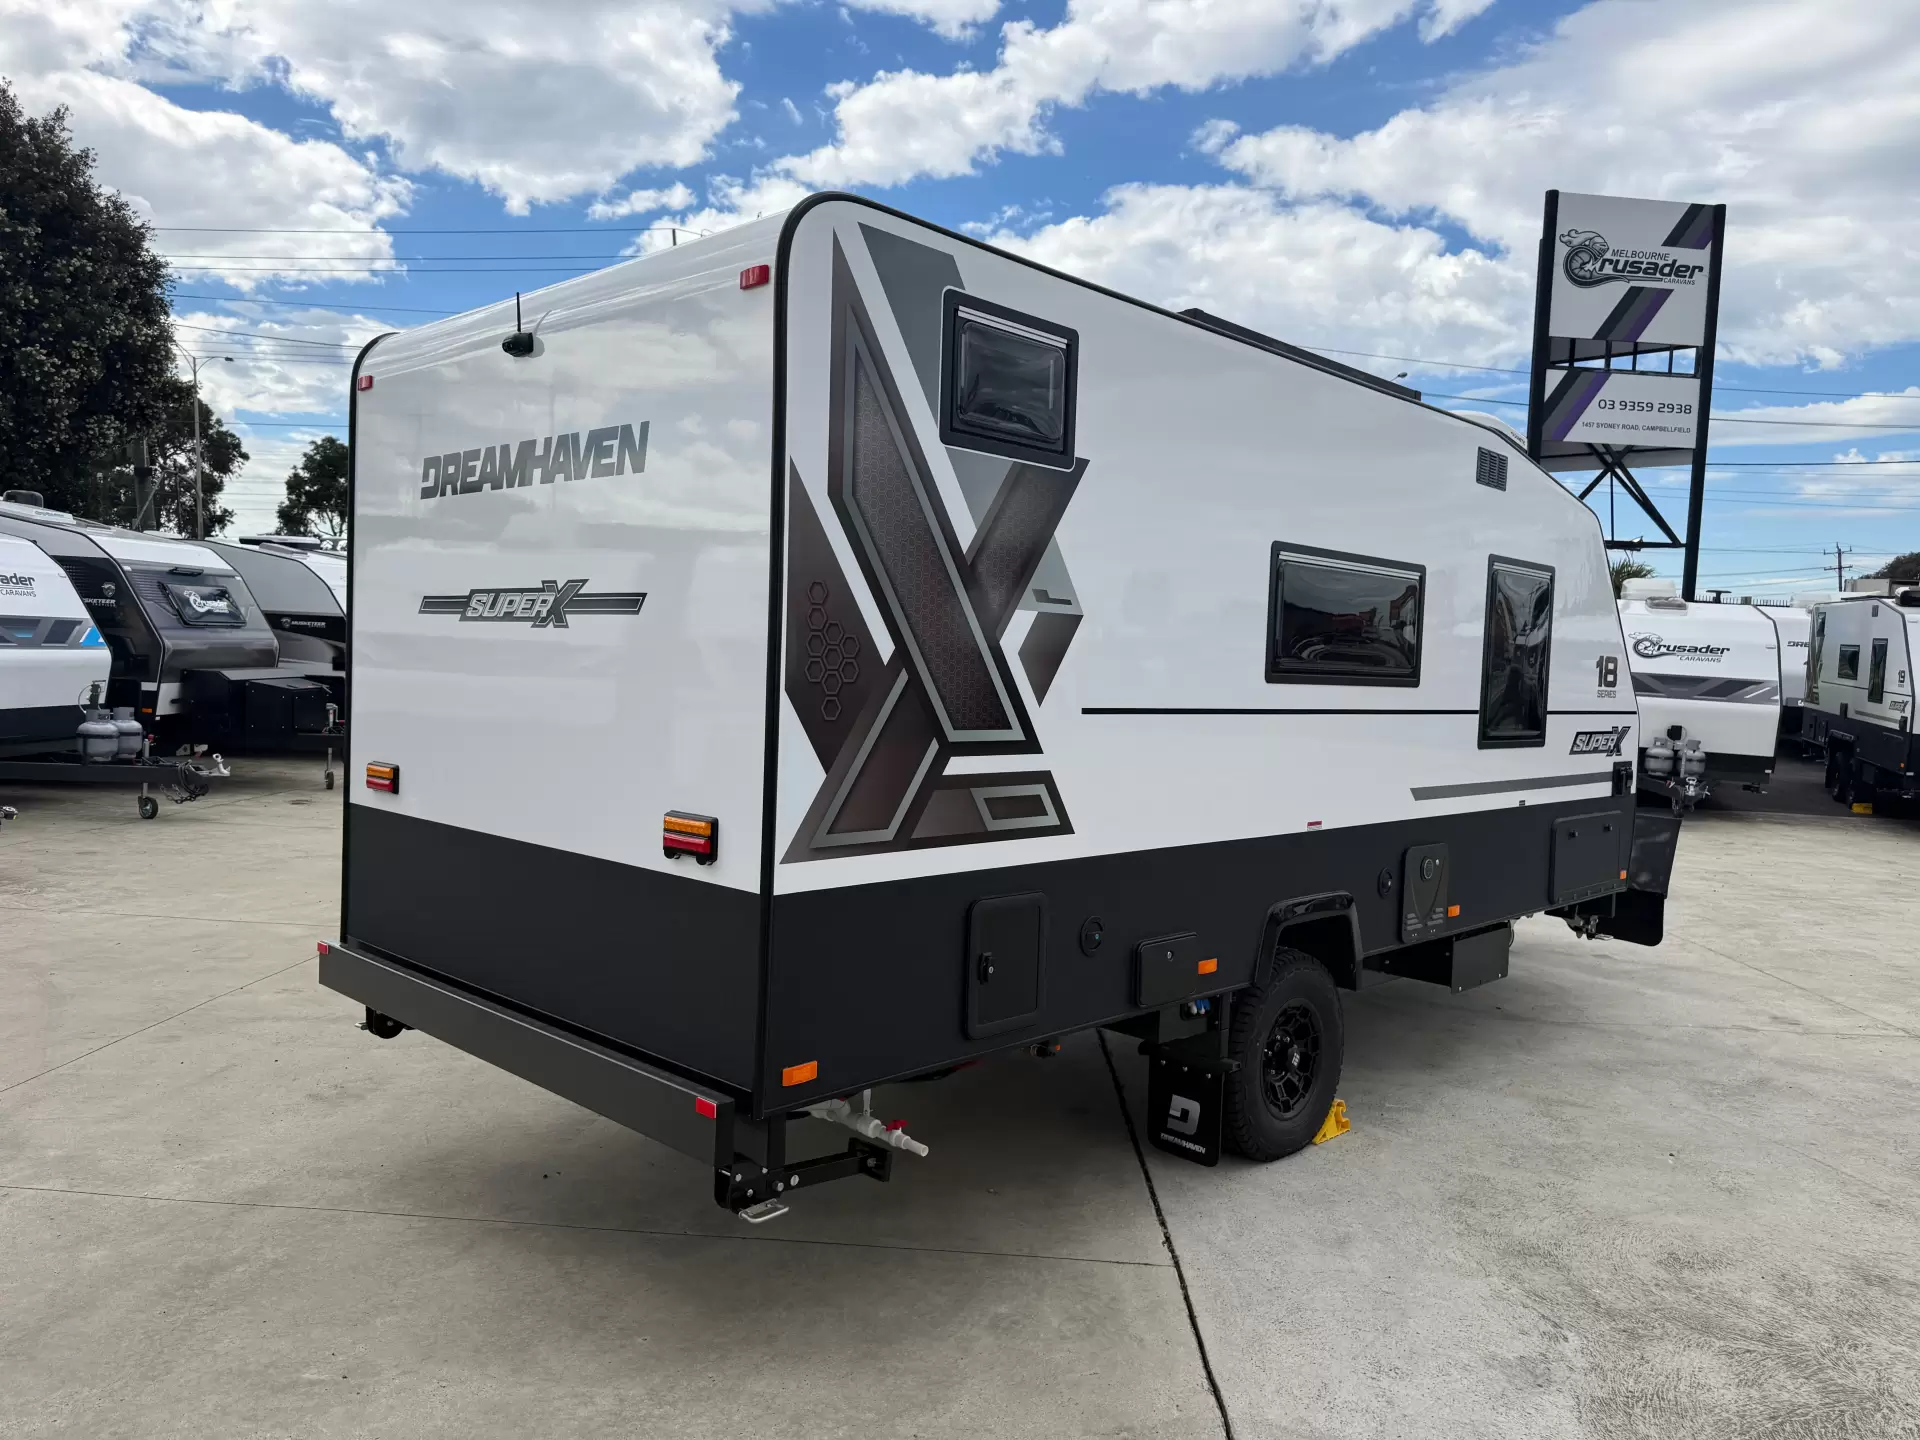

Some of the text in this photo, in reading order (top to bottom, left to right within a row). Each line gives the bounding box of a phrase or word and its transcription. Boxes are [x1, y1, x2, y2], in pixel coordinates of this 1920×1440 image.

[1611, 249, 1670, 260] MELBOURNE
[1663, 278, 1696, 286] CARAVANS
[1598, 399, 1692, 415] 03 9359 2938
[1596, 422, 1621, 430] SYDNEY
[1642, 425, 1691, 433] CAMPBELLFIELD
[420, 420, 650, 500] DREAMHAVEN
[0, 572, 35, 587] ader
[0, 589, 37, 597] CARAVANS
[1680, 655, 1722, 663] CARAVANS
[1596, 655, 1618, 688] 18
[1597, 690, 1617, 698] SERIES
